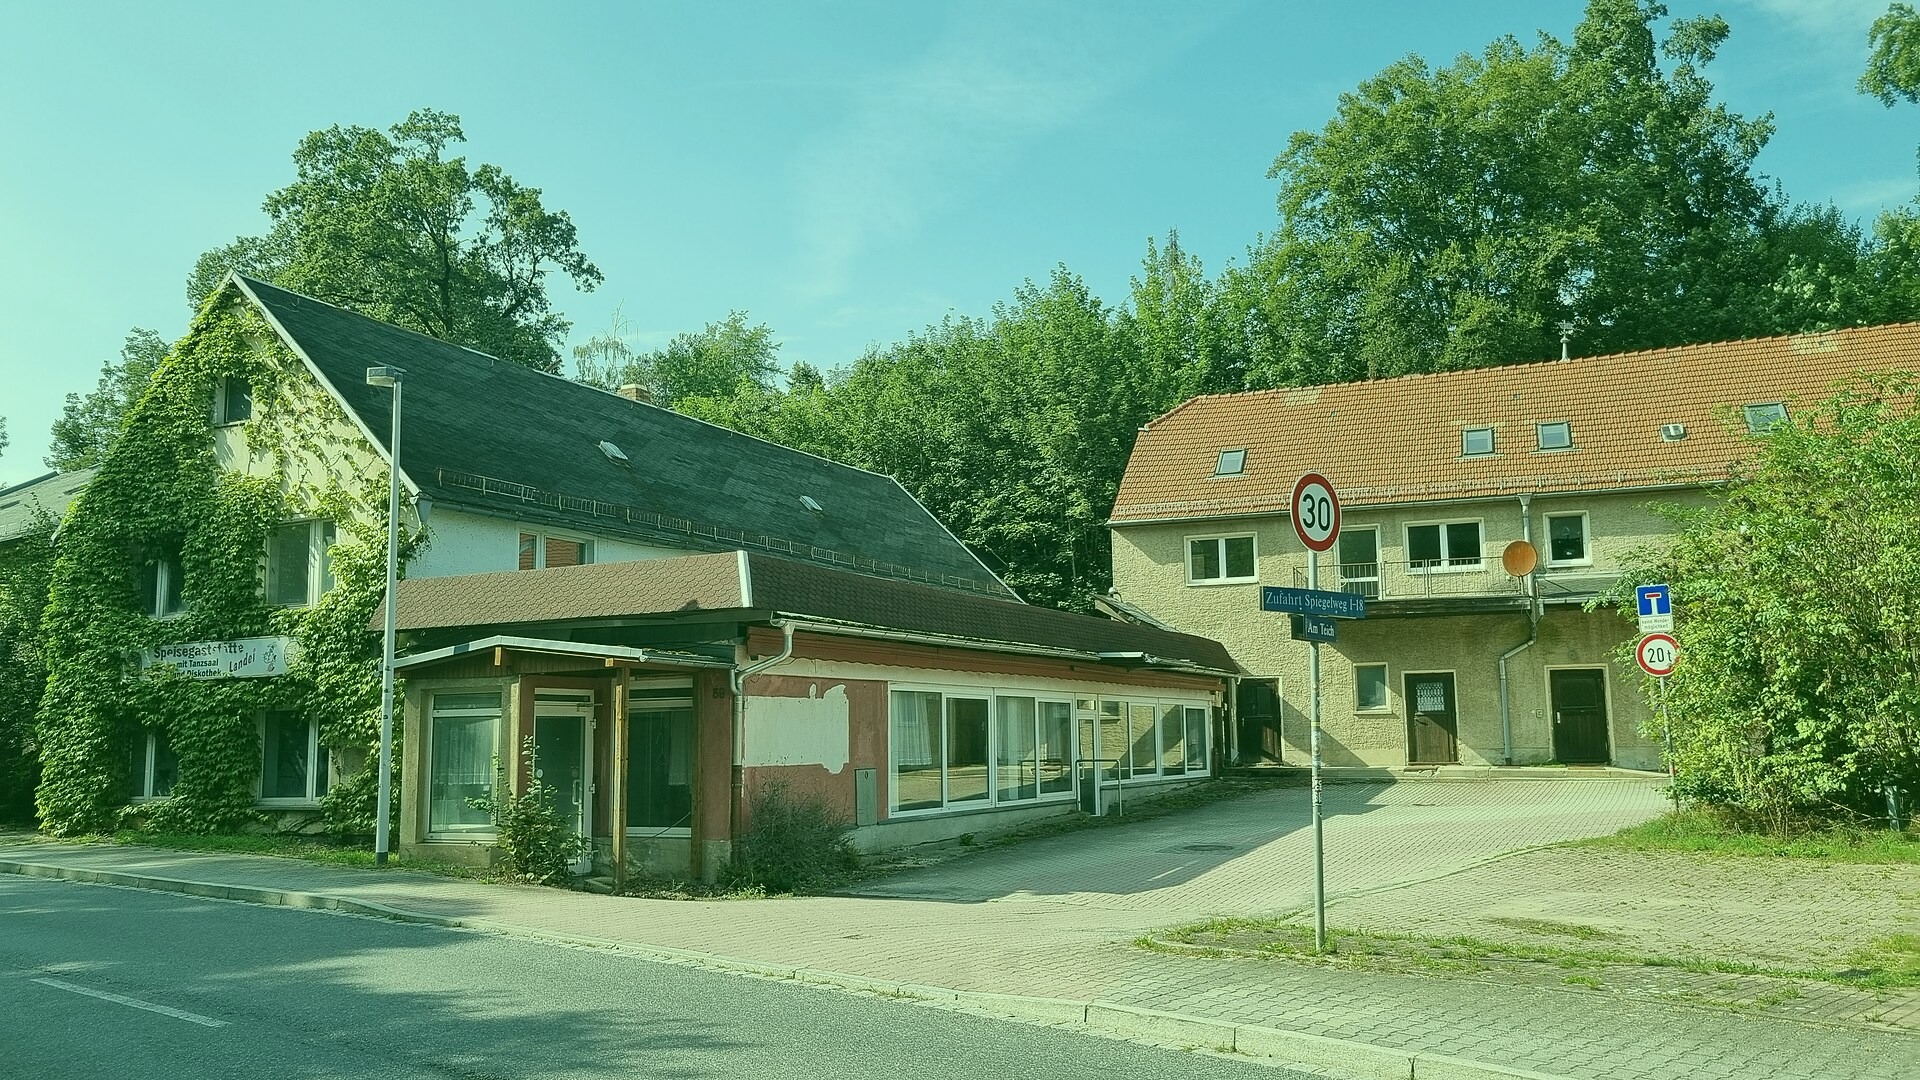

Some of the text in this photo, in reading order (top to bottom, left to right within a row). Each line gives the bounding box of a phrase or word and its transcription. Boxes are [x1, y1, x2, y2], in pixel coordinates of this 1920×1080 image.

[1302, 493, 1331, 532] 30
[1265, 590, 1364, 612] Zufahrt Spiegelweg 1-18
[1307, 621, 1335, 637] Am Teich
[176, 658, 219, 668] mit Tanzsaal
[229, 648, 256, 673] Landei
[1647, 647, 1673, 663] 20 t
